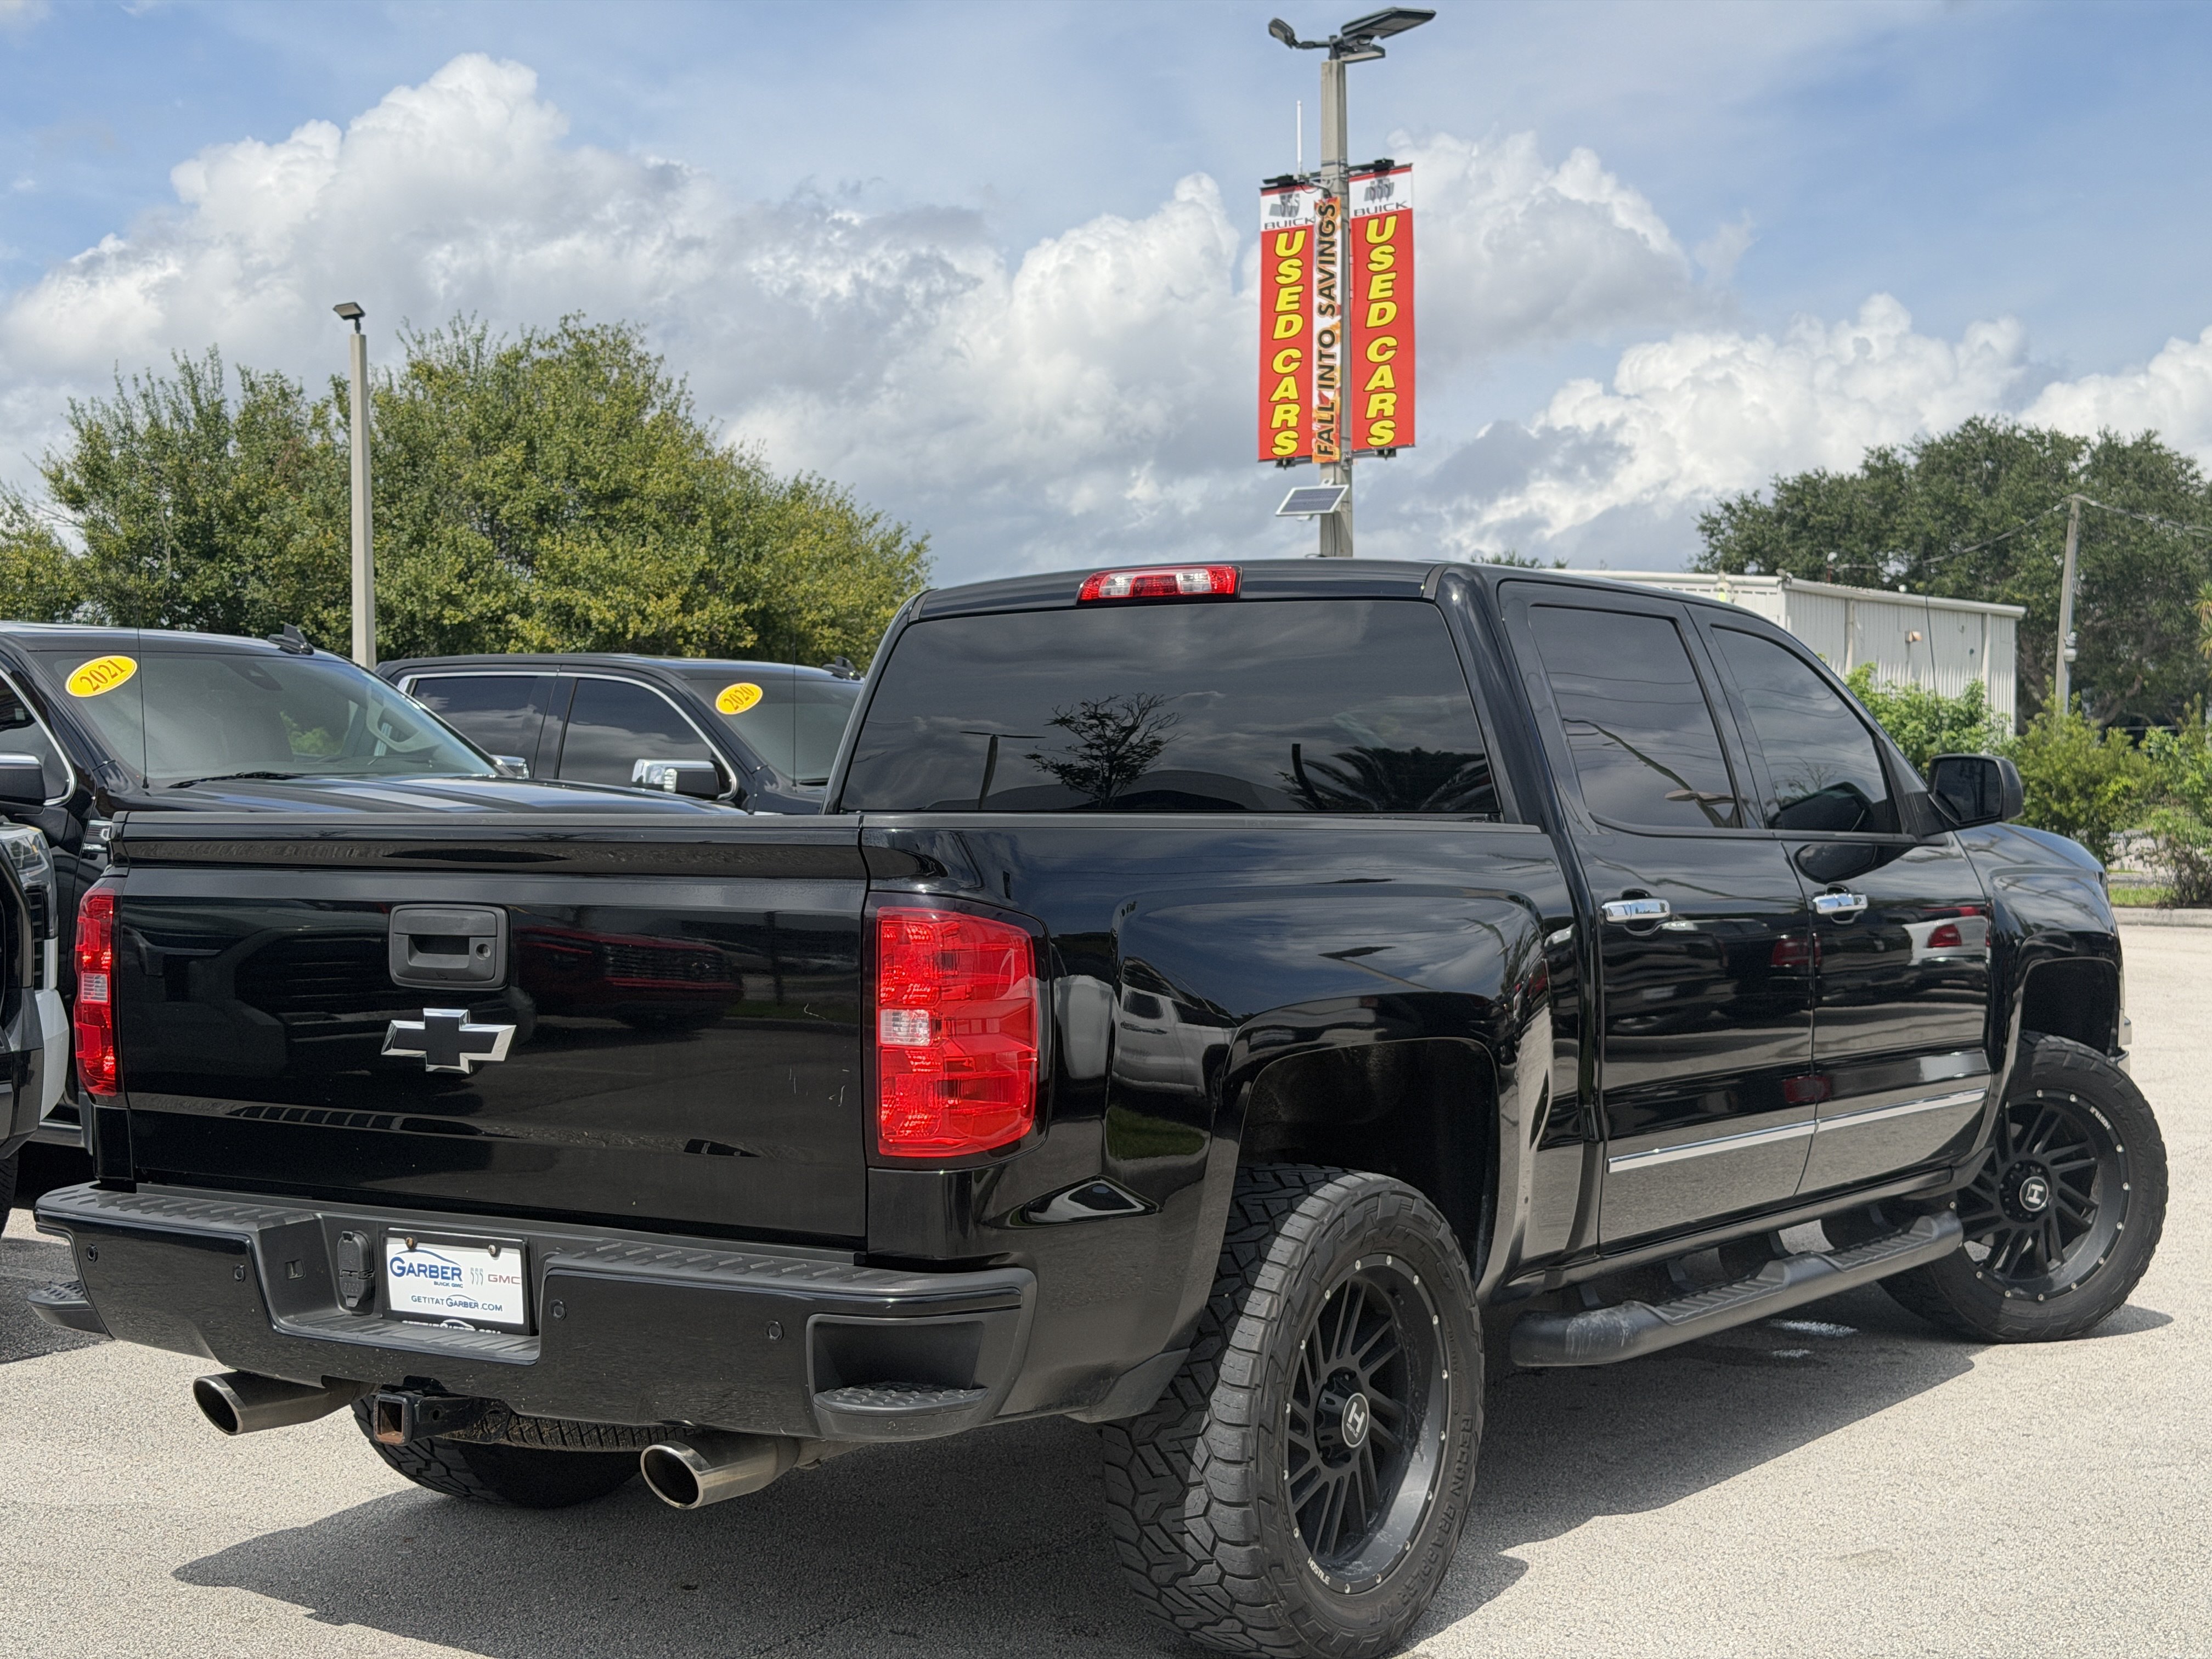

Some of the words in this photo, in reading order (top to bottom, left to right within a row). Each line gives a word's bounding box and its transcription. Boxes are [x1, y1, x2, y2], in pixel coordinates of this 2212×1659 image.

[1264, 217, 1316, 230] BUICK
[1353, 201, 1408, 217] BUICK
[1317, 203, 1338, 319] SAVINGS
[1364, 213, 1398, 329] USED
[1272, 229, 1307, 340] USED
[1317, 329, 1337, 391] INTO
[1268, 347, 1302, 456] CARS
[1363, 335, 1398, 447] CARS
[1317, 399, 1336, 456] FALL
[79, 659, 127, 692] 2021
[723, 685, 754, 711] 2020
[390, 1256, 462, 1282] GARBER
[487, 1273, 521, 1285] GMC
[1307, 1556, 1330, 1585] HOSTILE
